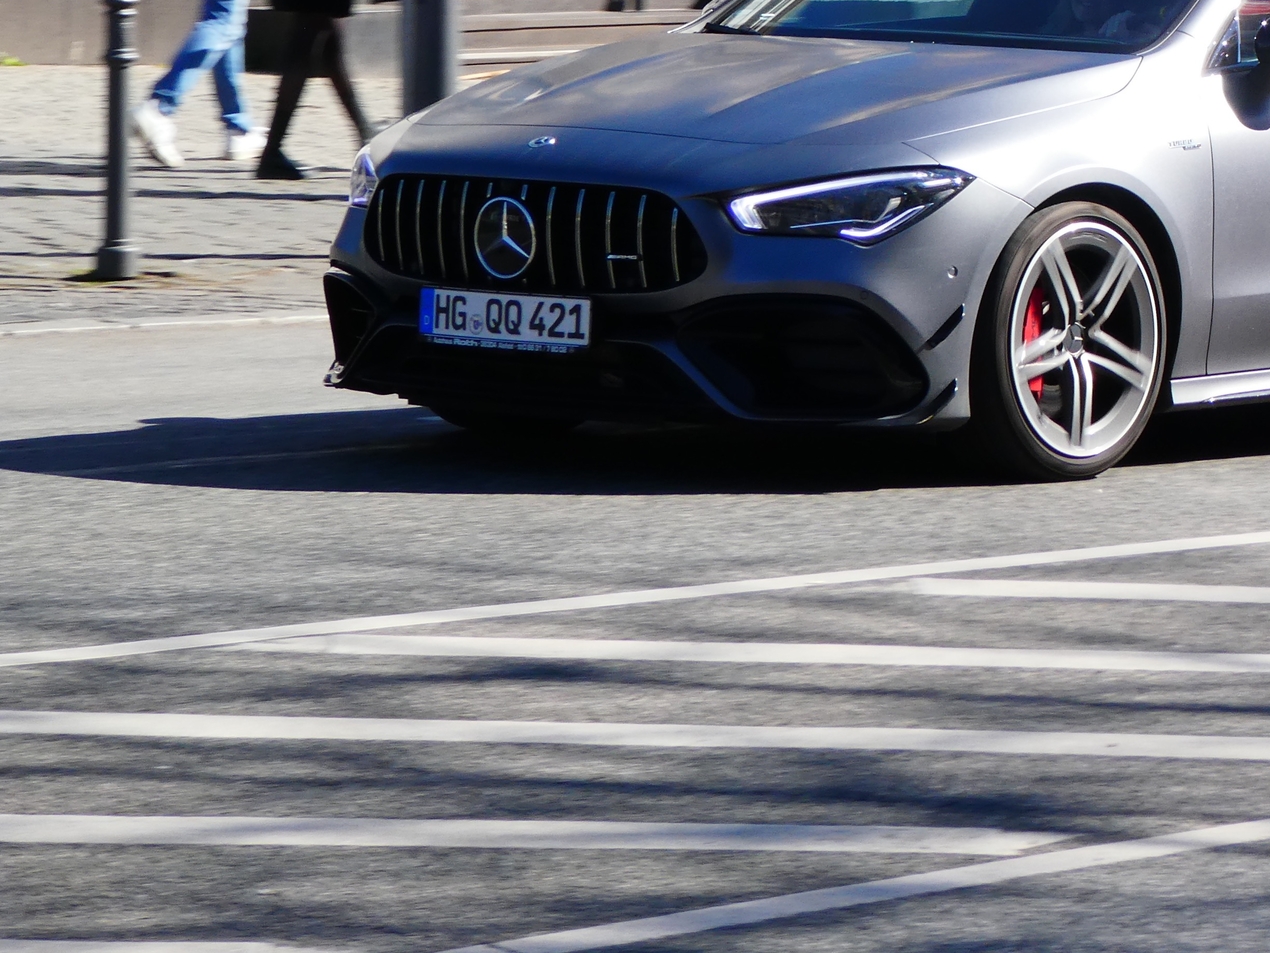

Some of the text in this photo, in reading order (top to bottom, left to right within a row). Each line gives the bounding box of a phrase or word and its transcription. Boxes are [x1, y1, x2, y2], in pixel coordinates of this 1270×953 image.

[435, 293, 585, 340] HG QQ 421
